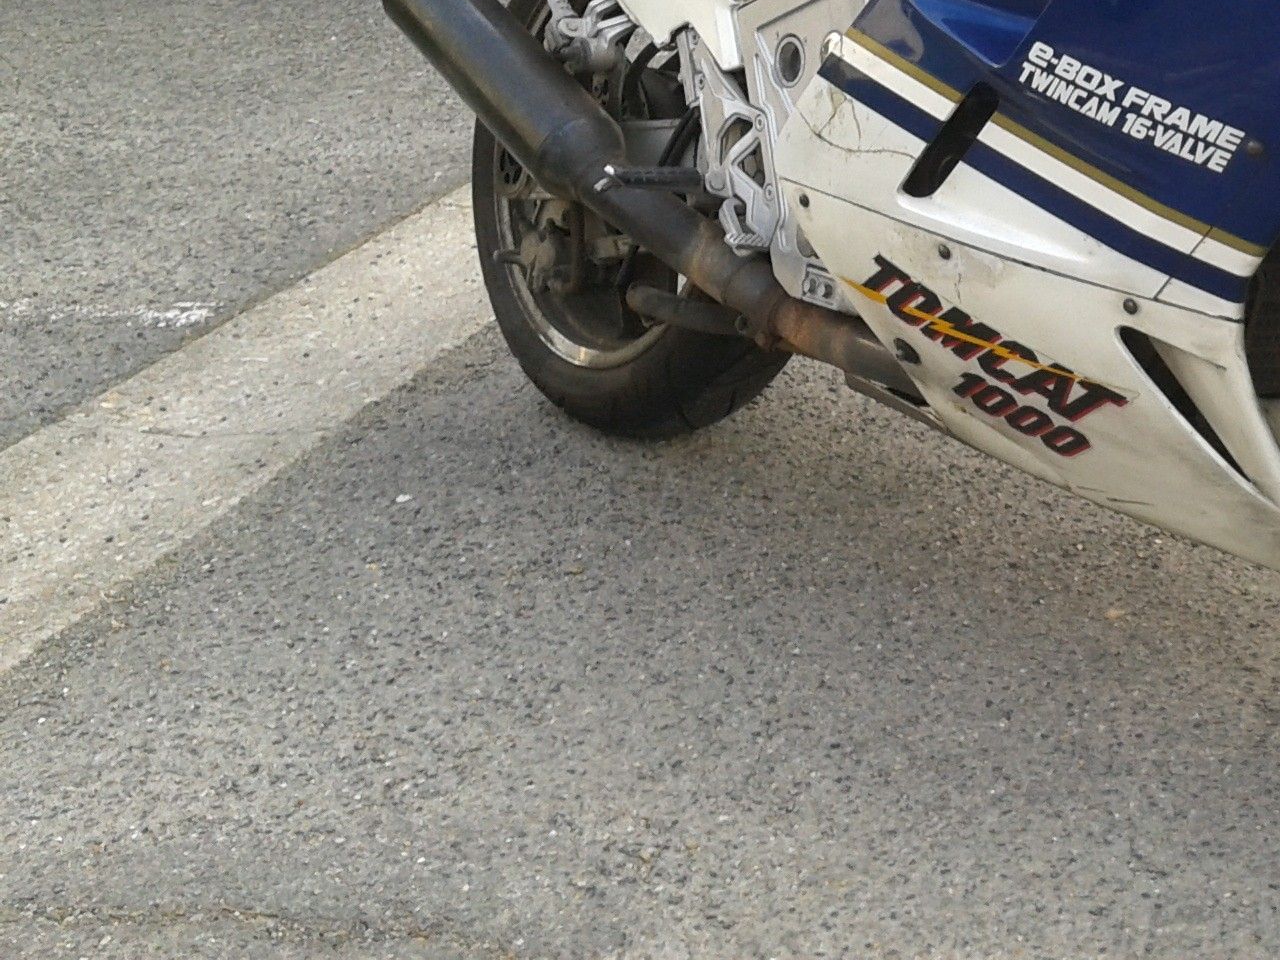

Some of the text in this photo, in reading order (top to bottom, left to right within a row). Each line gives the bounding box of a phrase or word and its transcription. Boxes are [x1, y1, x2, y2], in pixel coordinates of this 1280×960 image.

[1018, 61, 1232, 173] TWINCAM 16-VALVE
[1028, 41, 1245, 152] e-BOX FRAME
[860, 251, 1129, 422] TOMCAT
[952, 372, 1092, 457] 1000
